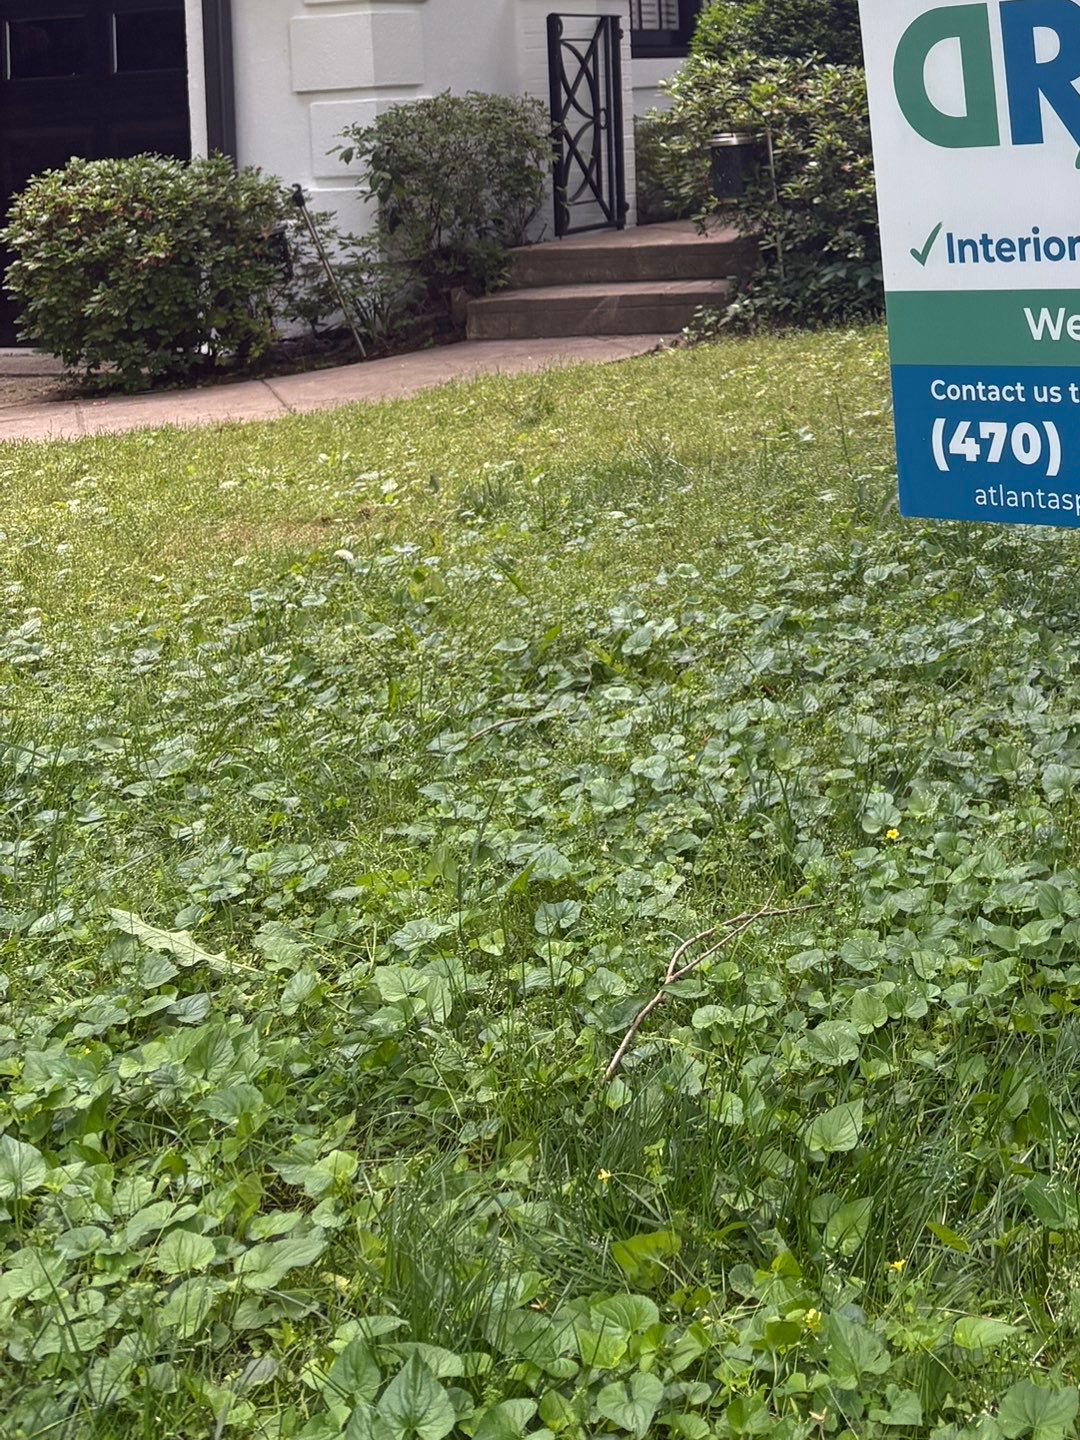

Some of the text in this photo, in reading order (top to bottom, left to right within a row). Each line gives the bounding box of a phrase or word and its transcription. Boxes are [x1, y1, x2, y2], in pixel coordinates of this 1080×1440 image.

[930, 379, 1025, 403] Contact
[1033, 384, 1062, 404] us
[931, 417, 1063, 477] (470)
